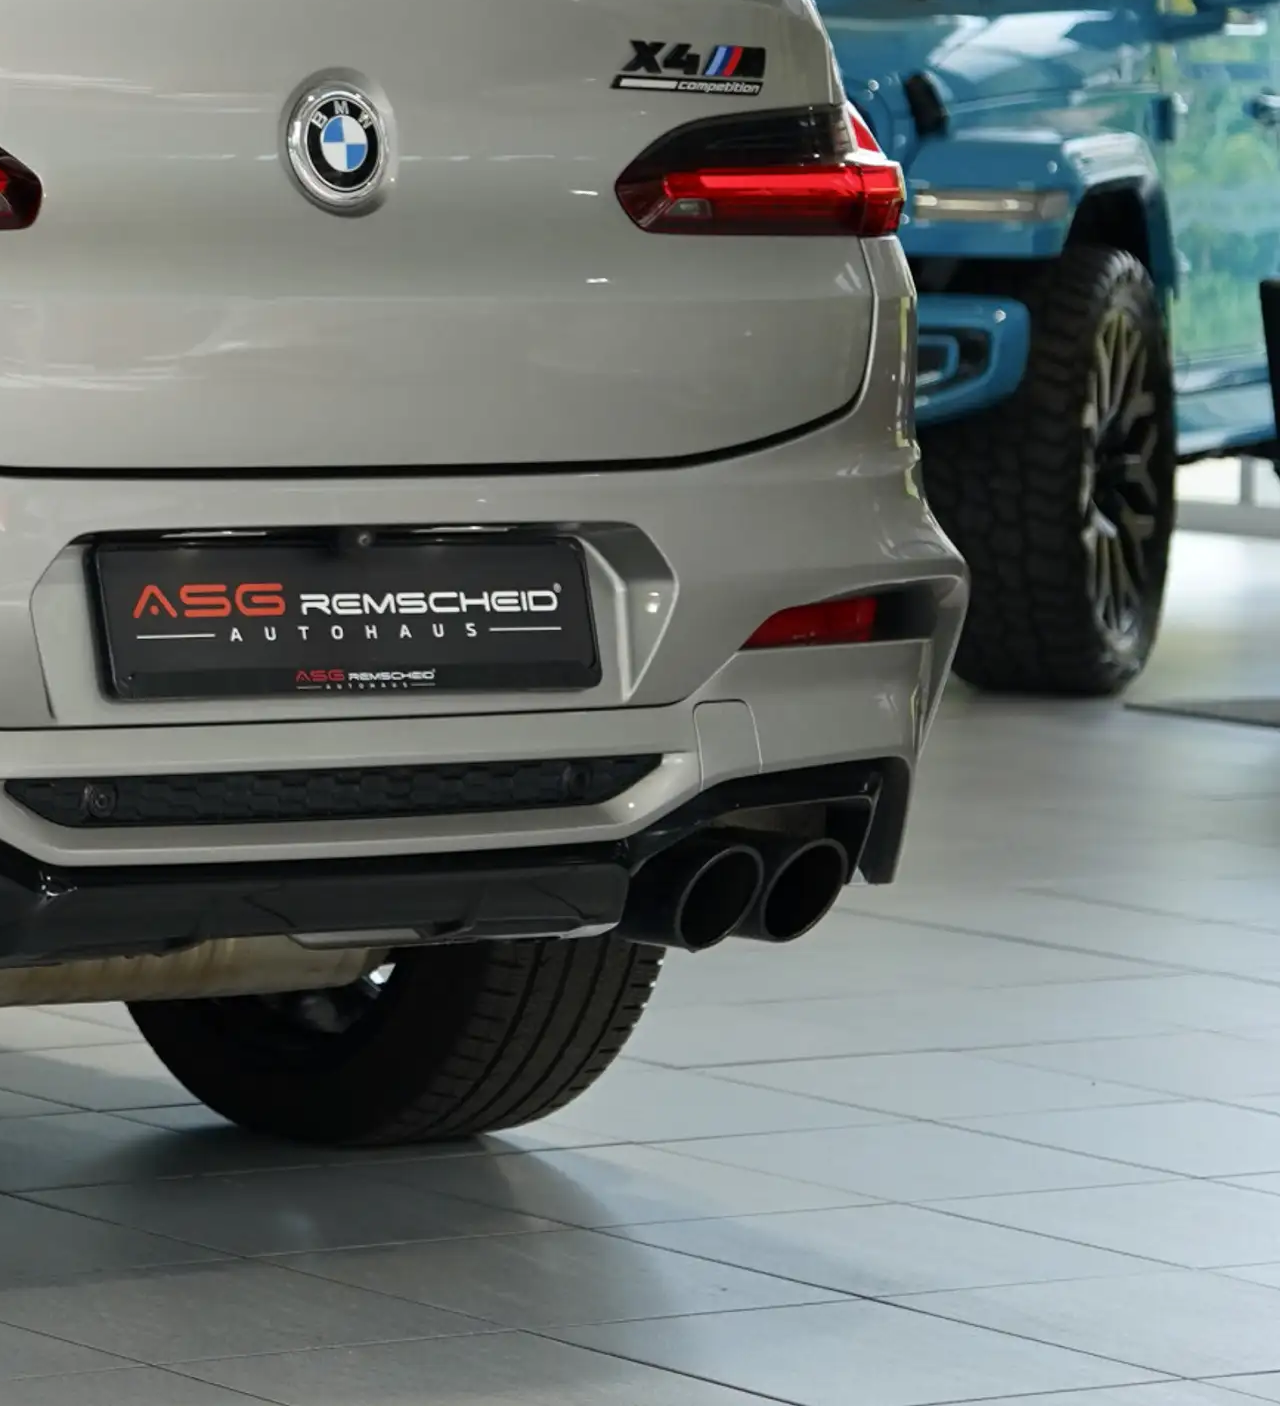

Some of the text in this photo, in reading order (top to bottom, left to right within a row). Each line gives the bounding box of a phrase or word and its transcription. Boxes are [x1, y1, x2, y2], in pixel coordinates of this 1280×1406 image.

[311, 100, 374, 130] BMW
[133, 583, 558, 619] ASG REMSCHEID
[230, 622, 477, 642] AUTOHAUS
[295, 669, 345, 682] ASG
